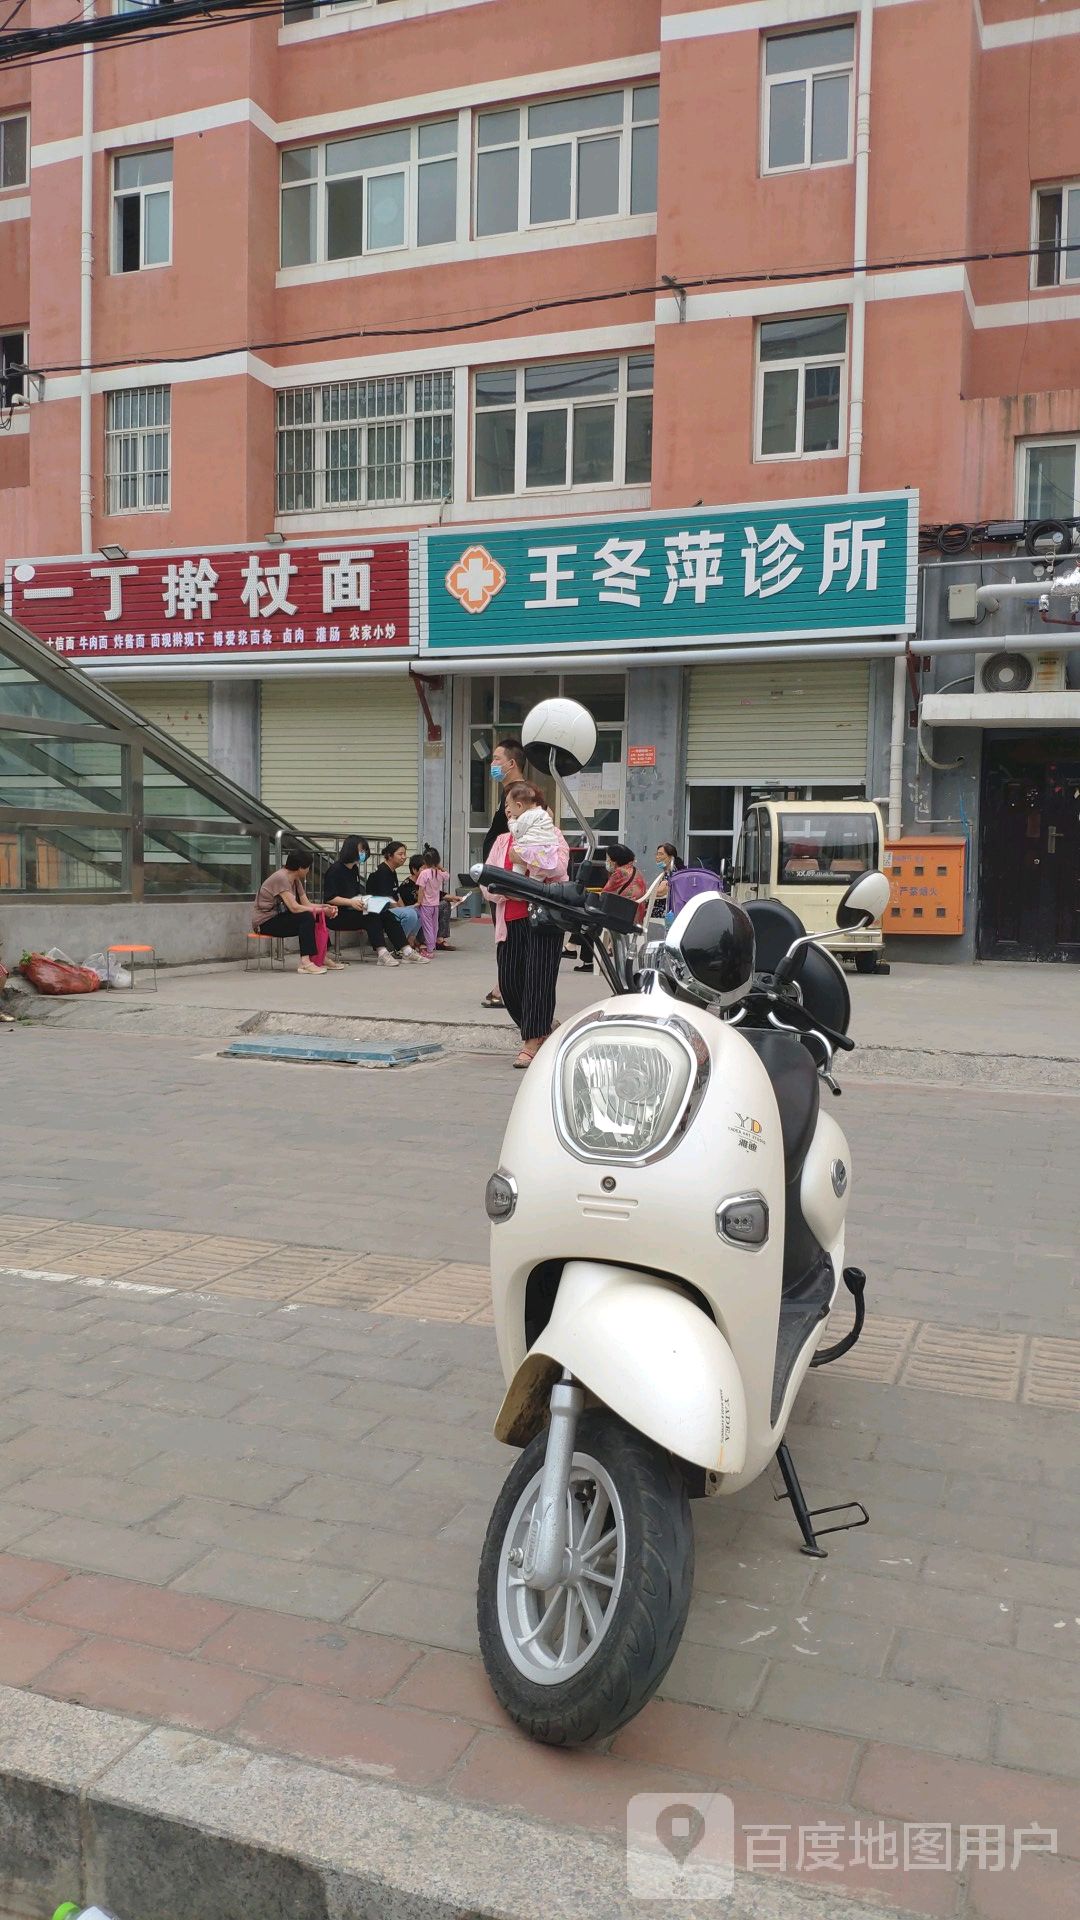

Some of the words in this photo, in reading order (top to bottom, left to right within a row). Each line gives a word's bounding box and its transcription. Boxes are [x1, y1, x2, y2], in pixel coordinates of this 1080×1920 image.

[23, 549, 375, 621] 一丁擀杖面
[524, 516, 886, 609] 王冬萍诊所
[79, 635, 108, 650] 牛肉面
[113, 633, 145, 649] 炸酱面
[213, 629, 273, 647] 博爱浆面条
[282, 627, 305, 643] 卤肉
[316, 626, 340, 643] 灌肠
[349, 623, 396, 641] 农家小炒
